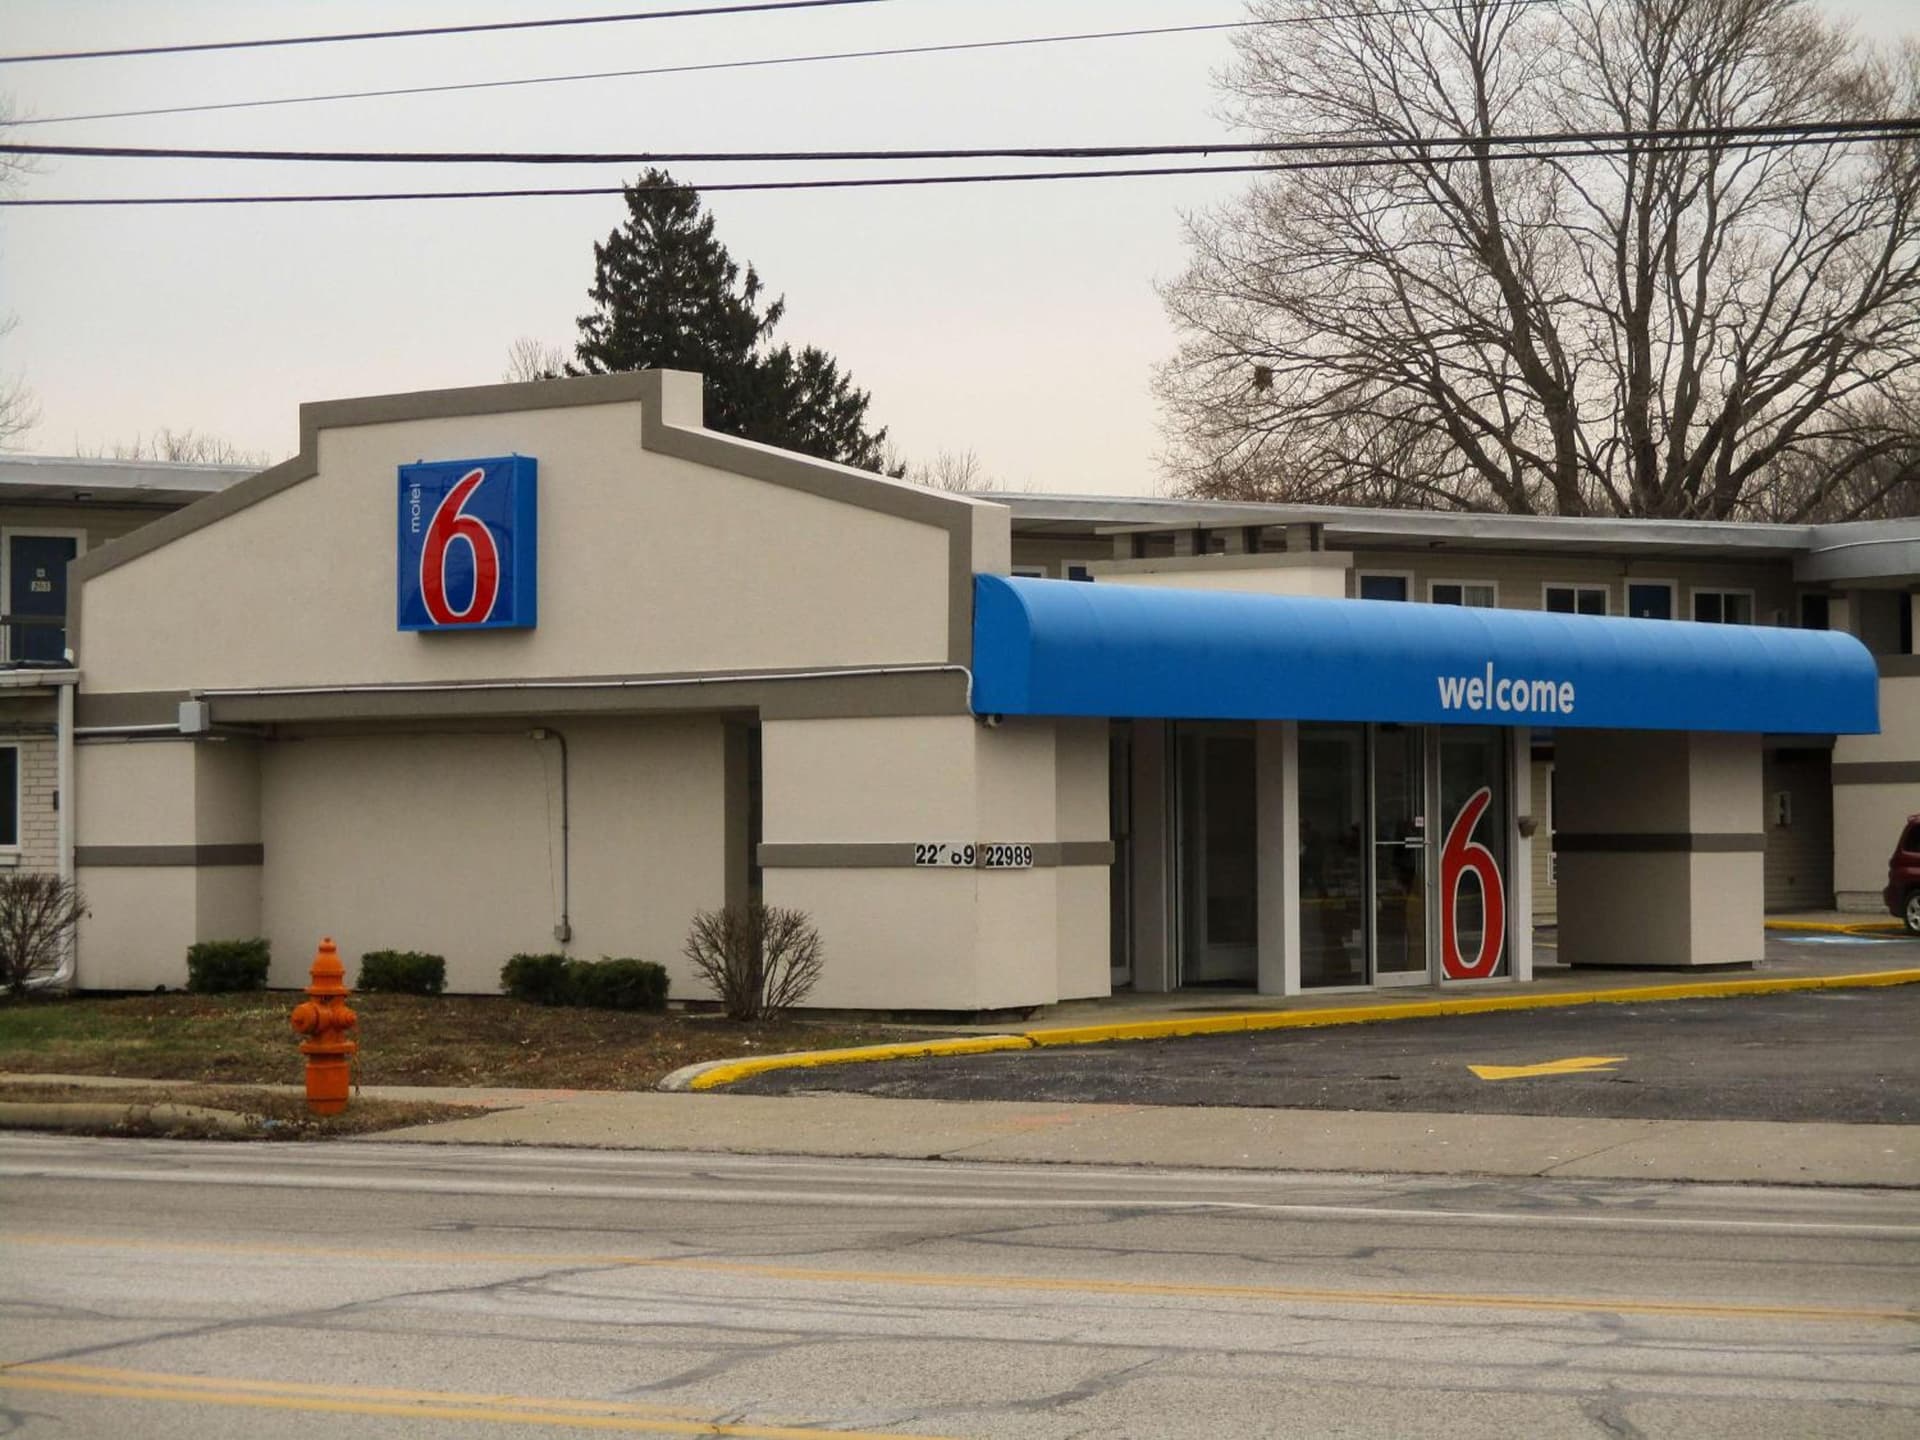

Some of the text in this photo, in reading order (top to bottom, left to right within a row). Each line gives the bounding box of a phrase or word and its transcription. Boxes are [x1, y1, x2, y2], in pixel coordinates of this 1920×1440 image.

[410, 483, 421, 533] motel
[420, 467, 500, 625] 6
[1438, 662, 1575, 714] welcome
[985, 846, 1032, 866] 22989
[1440, 786, 1505, 978] 6
